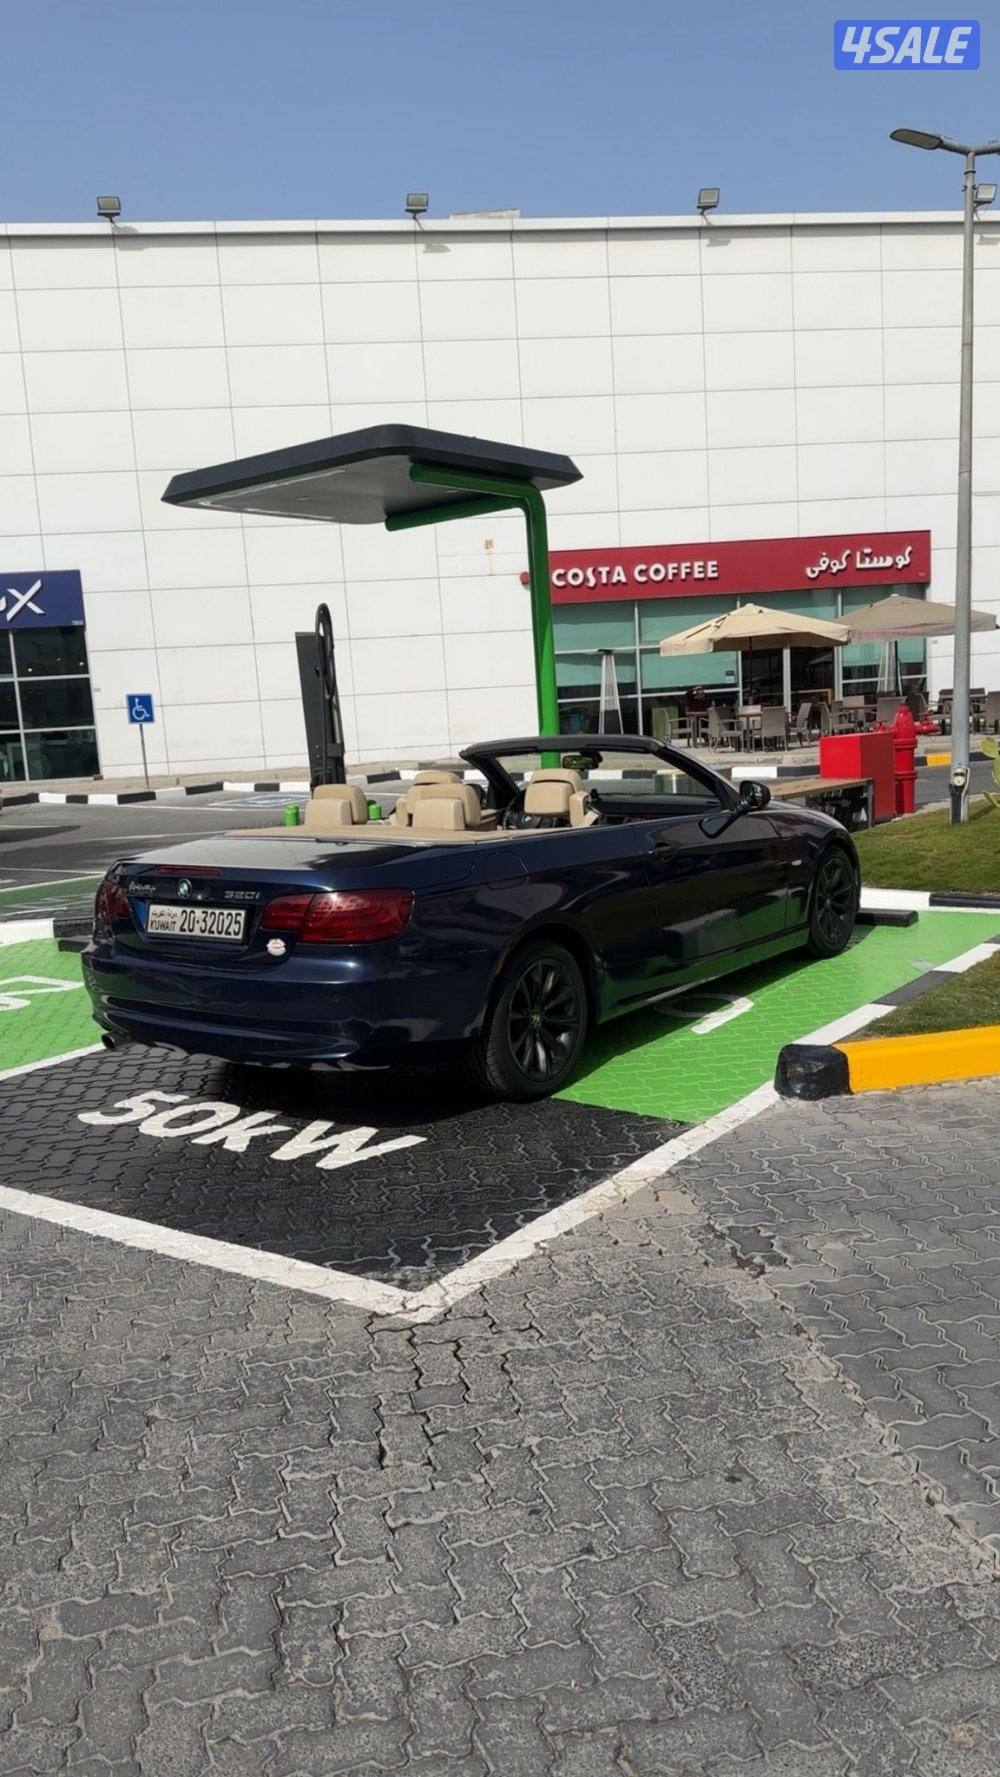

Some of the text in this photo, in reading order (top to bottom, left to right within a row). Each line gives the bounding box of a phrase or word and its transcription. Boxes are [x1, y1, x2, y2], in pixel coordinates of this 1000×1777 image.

[855, 545, 913, 569] كوستا
[551, 560, 719, 587] COSTA COFFEE
[150, 920, 177, 932] KUWAIT
